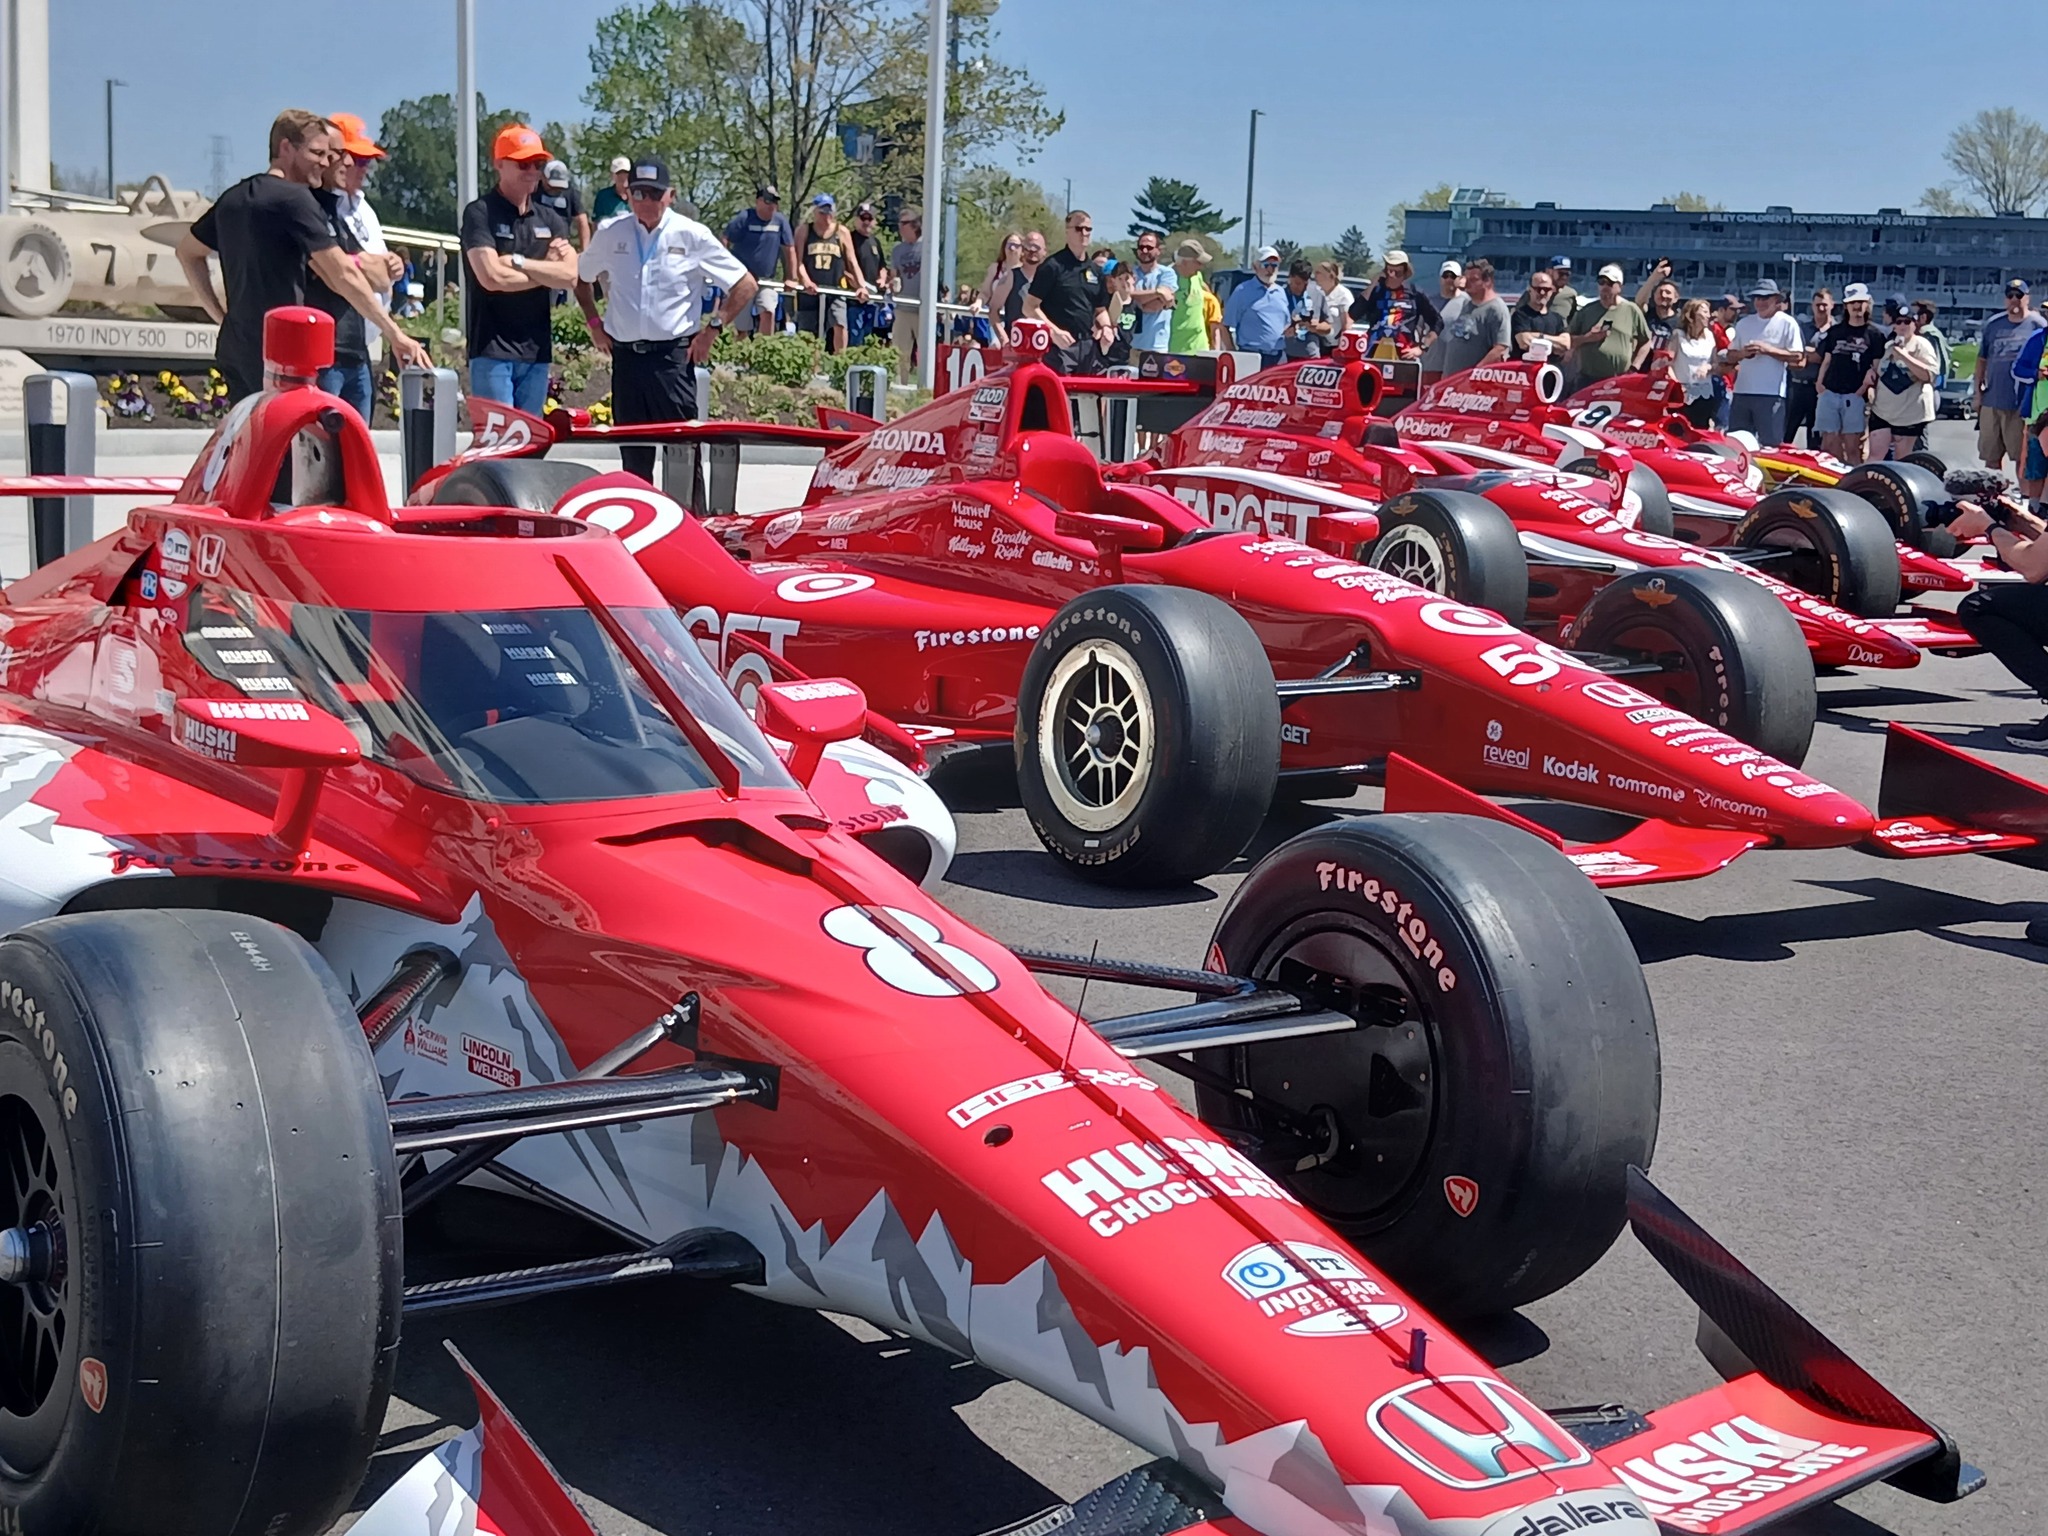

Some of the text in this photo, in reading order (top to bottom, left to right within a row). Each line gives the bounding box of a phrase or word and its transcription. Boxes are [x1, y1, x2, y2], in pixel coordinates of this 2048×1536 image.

[47, 326, 218, 349] 1970 INDY 500 DRI
[1298, 367, 1337, 386] IZOD
[1470, 368, 1530, 386] HONDA
[974, 389, 1004, 404] IZOD
[1224, 384, 1291, 405] HONDA
[1437, 387, 1498, 413] Energizer
[1227, 403, 1287, 429] Energizer
[1403, 417, 1454, 438] Polaroid
[1578, 405, 1612, 429] 9
[867, 429, 947, 455] HONDA
[866, 458, 935, 493] Energizer
[951, 501, 991, 518] Maxwell
[954, 515, 983, 531] House
[991, 527, 1032, 546] Breathe
[994, 543, 1025, 561] Right
[1032, 550, 1074, 572] Gillette
[914, 625, 1041, 652] Firestone
[1043, 607, 1142, 650] Firestone
[1848, 645, 1884, 668] Dove
[185, 717, 238, 752] HUSKI
[1281, 724, 1310, 744] GET
[1483, 743, 1531, 769] reveal
[1543, 755, 1599, 784] Kodak
[1608, 773, 1673, 800] TOMTOM
[1315, 861, 1456, 992] Firestone
[820, 904, 1000, 998] 8
[418, 1024, 448, 1045] SHERWIN
[463, 1037, 511, 1068] LINCOLN
[473, 1060, 515, 1086] WELDERS
[1513, 1501, 1650, 1536] dallara
